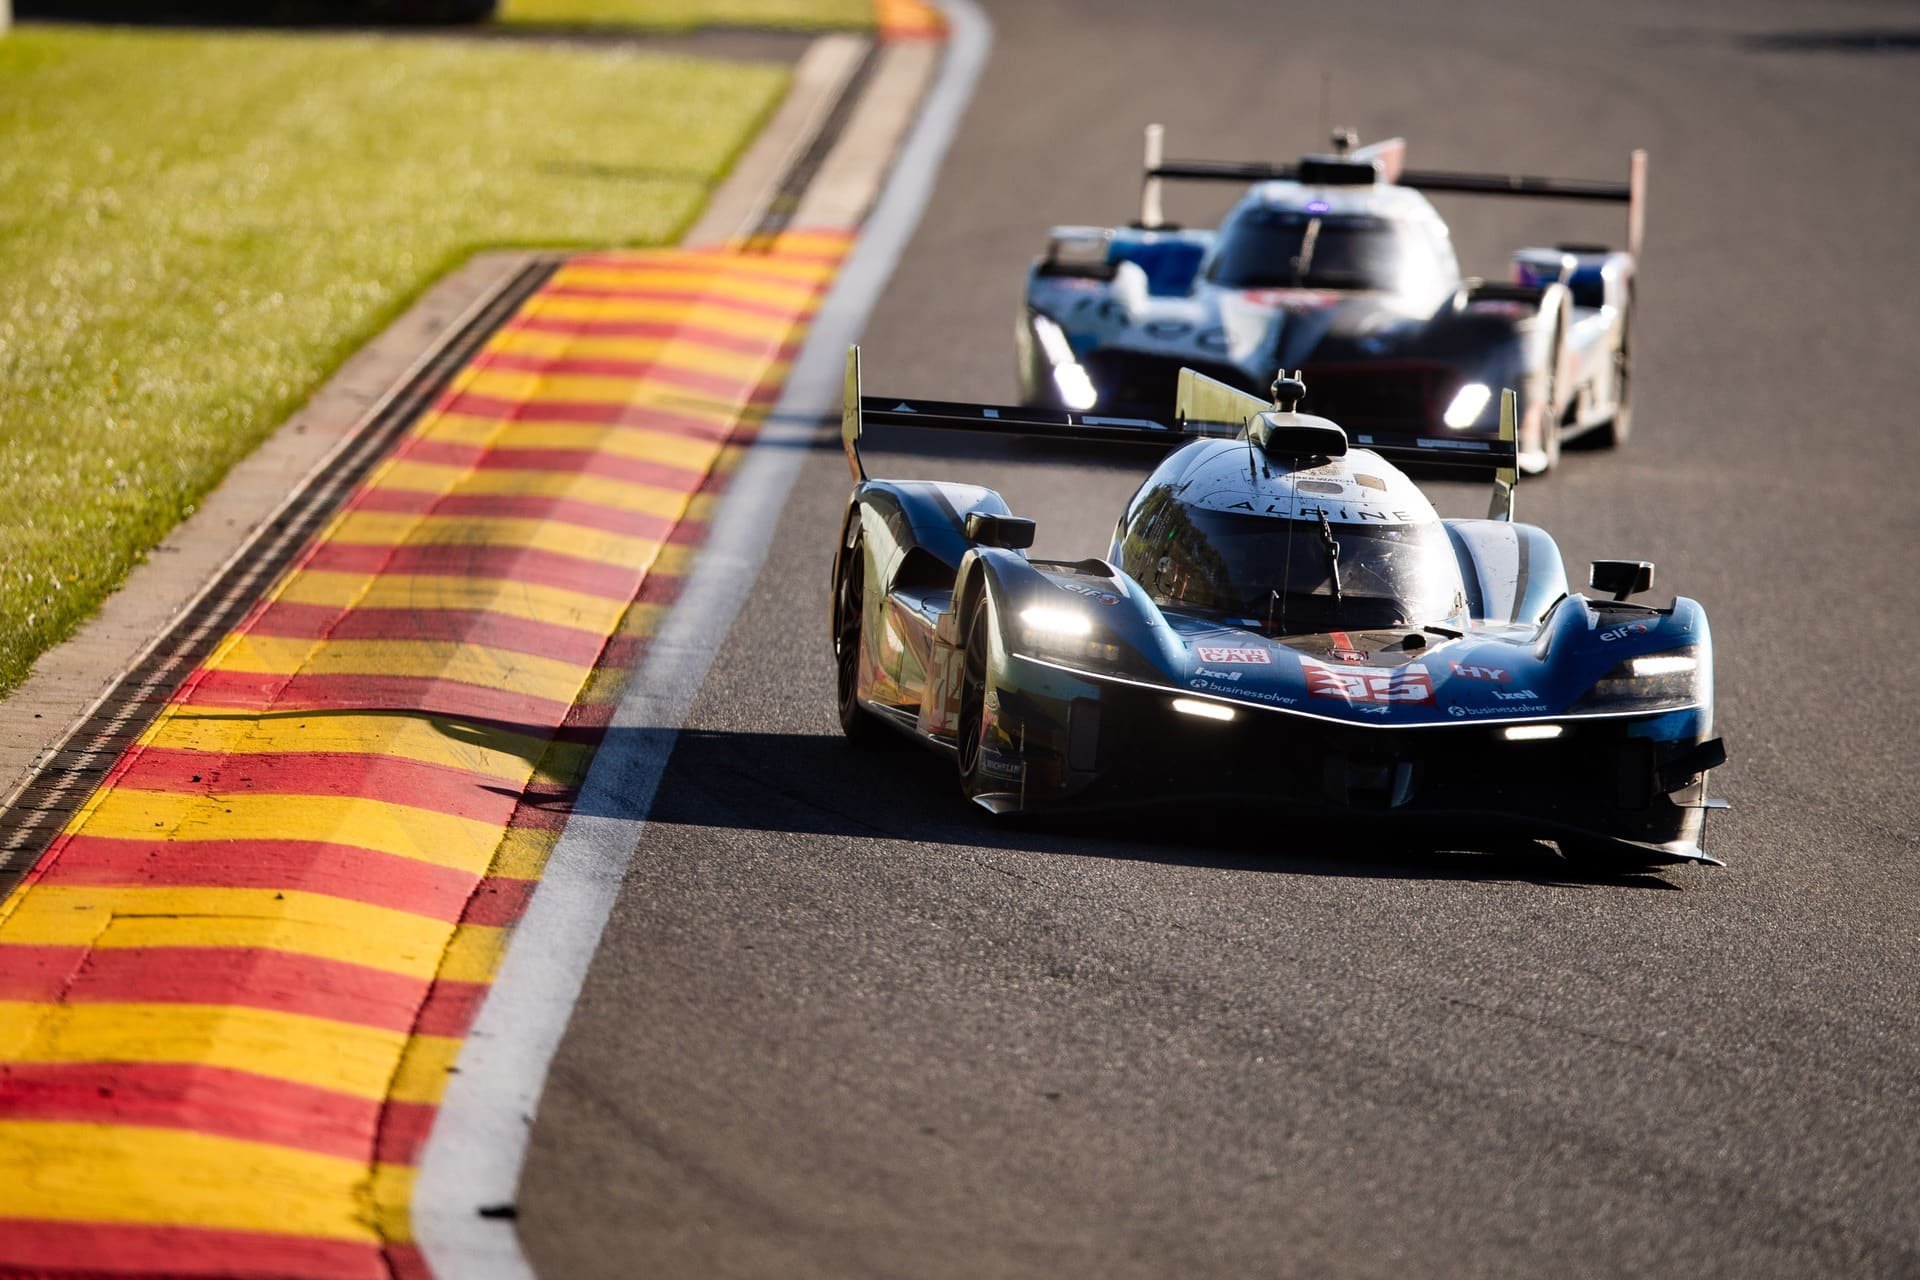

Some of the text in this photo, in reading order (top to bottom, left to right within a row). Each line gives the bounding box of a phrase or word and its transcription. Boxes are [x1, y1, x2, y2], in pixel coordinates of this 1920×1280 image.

[1227, 501, 1416, 521] ALPINE
[1064, 584, 1101, 597] elf
[1600, 627, 1629, 641] elf
[1205, 653, 1268, 662] CAR
[1454, 665, 1505, 680] HY
[1208, 682, 1298, 704] businessolver
[1465, 703, 1548, 715] businessolver
